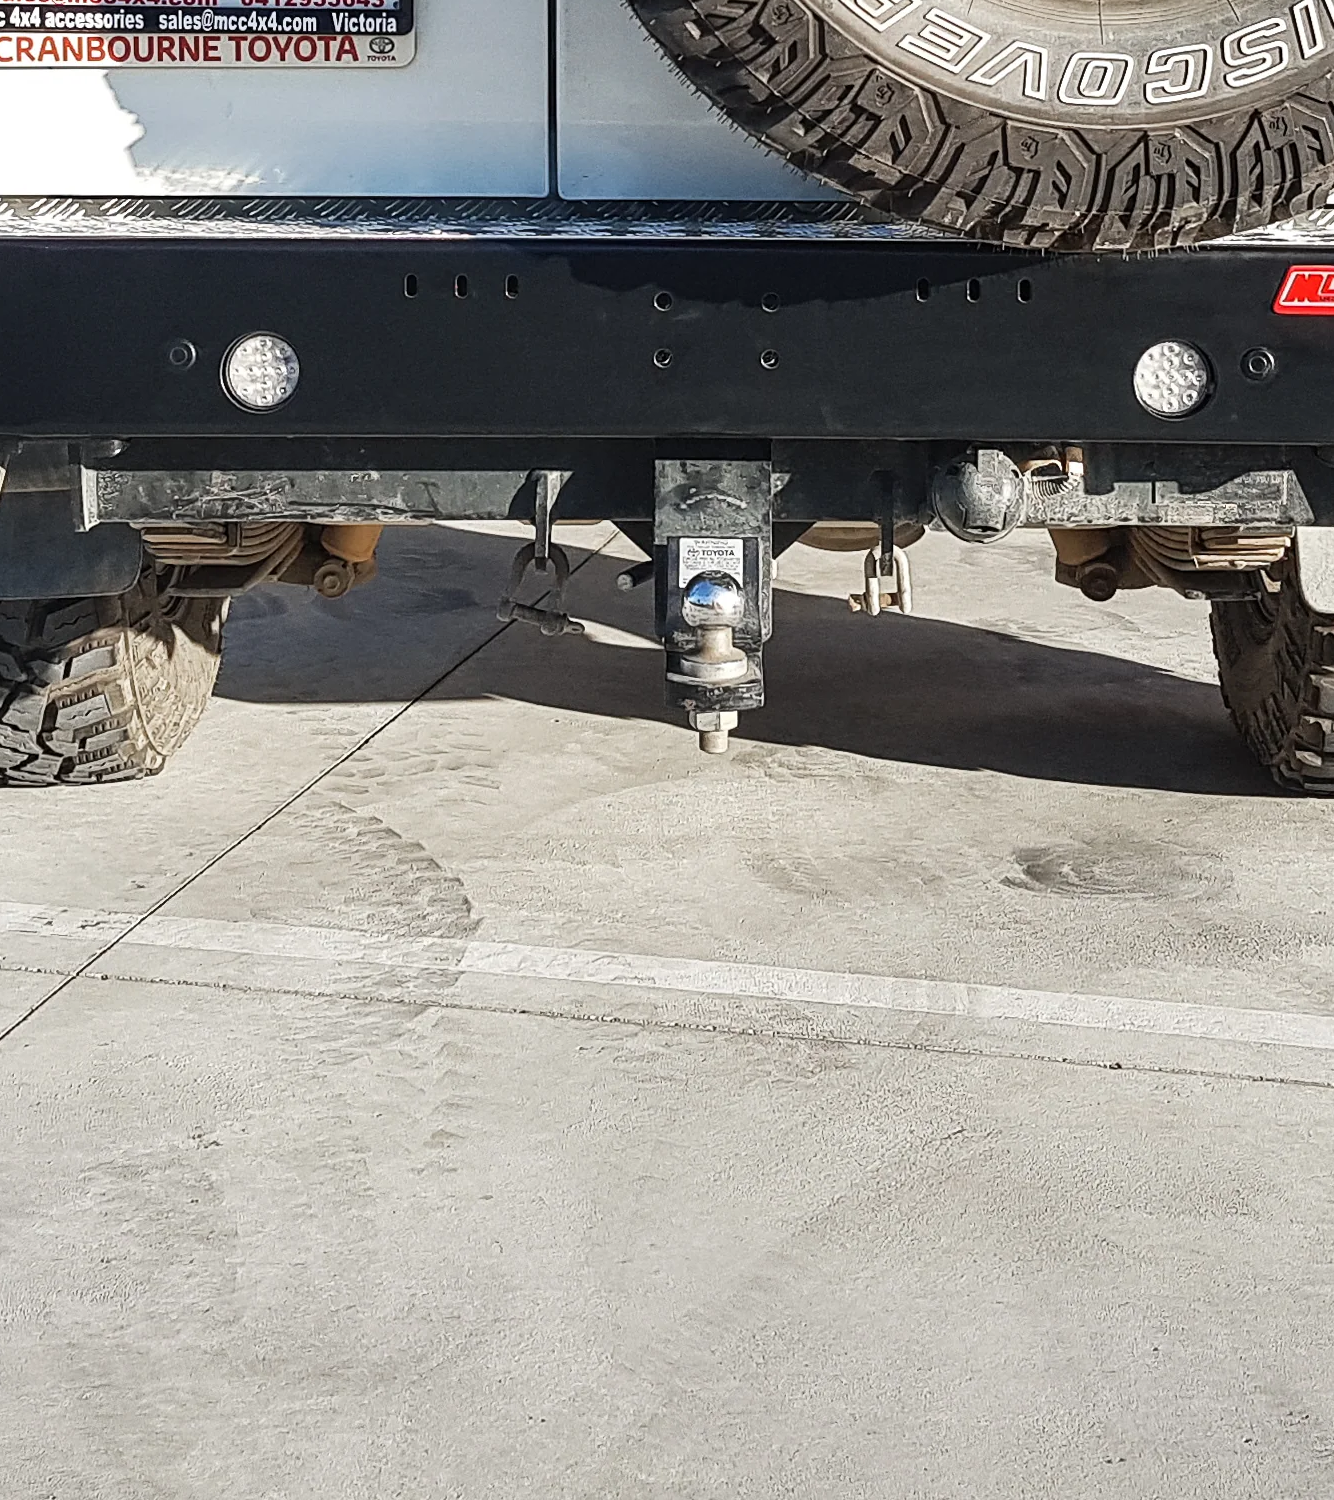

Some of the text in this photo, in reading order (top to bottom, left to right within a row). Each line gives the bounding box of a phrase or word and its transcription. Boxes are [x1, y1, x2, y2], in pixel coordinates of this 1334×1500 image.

[9, 6, 42, 28] 4x4
[44, 8, 145, 30] accessories
[158, 8, 318, 32] sales@mcc4x4.com
[331, 11, 398, 33] Victoria
[227, 34, 360, 63] TOYOTA
[366, 54, 397, 62] TOYOTA
[701, 548, 736, 557] TOYOTA
